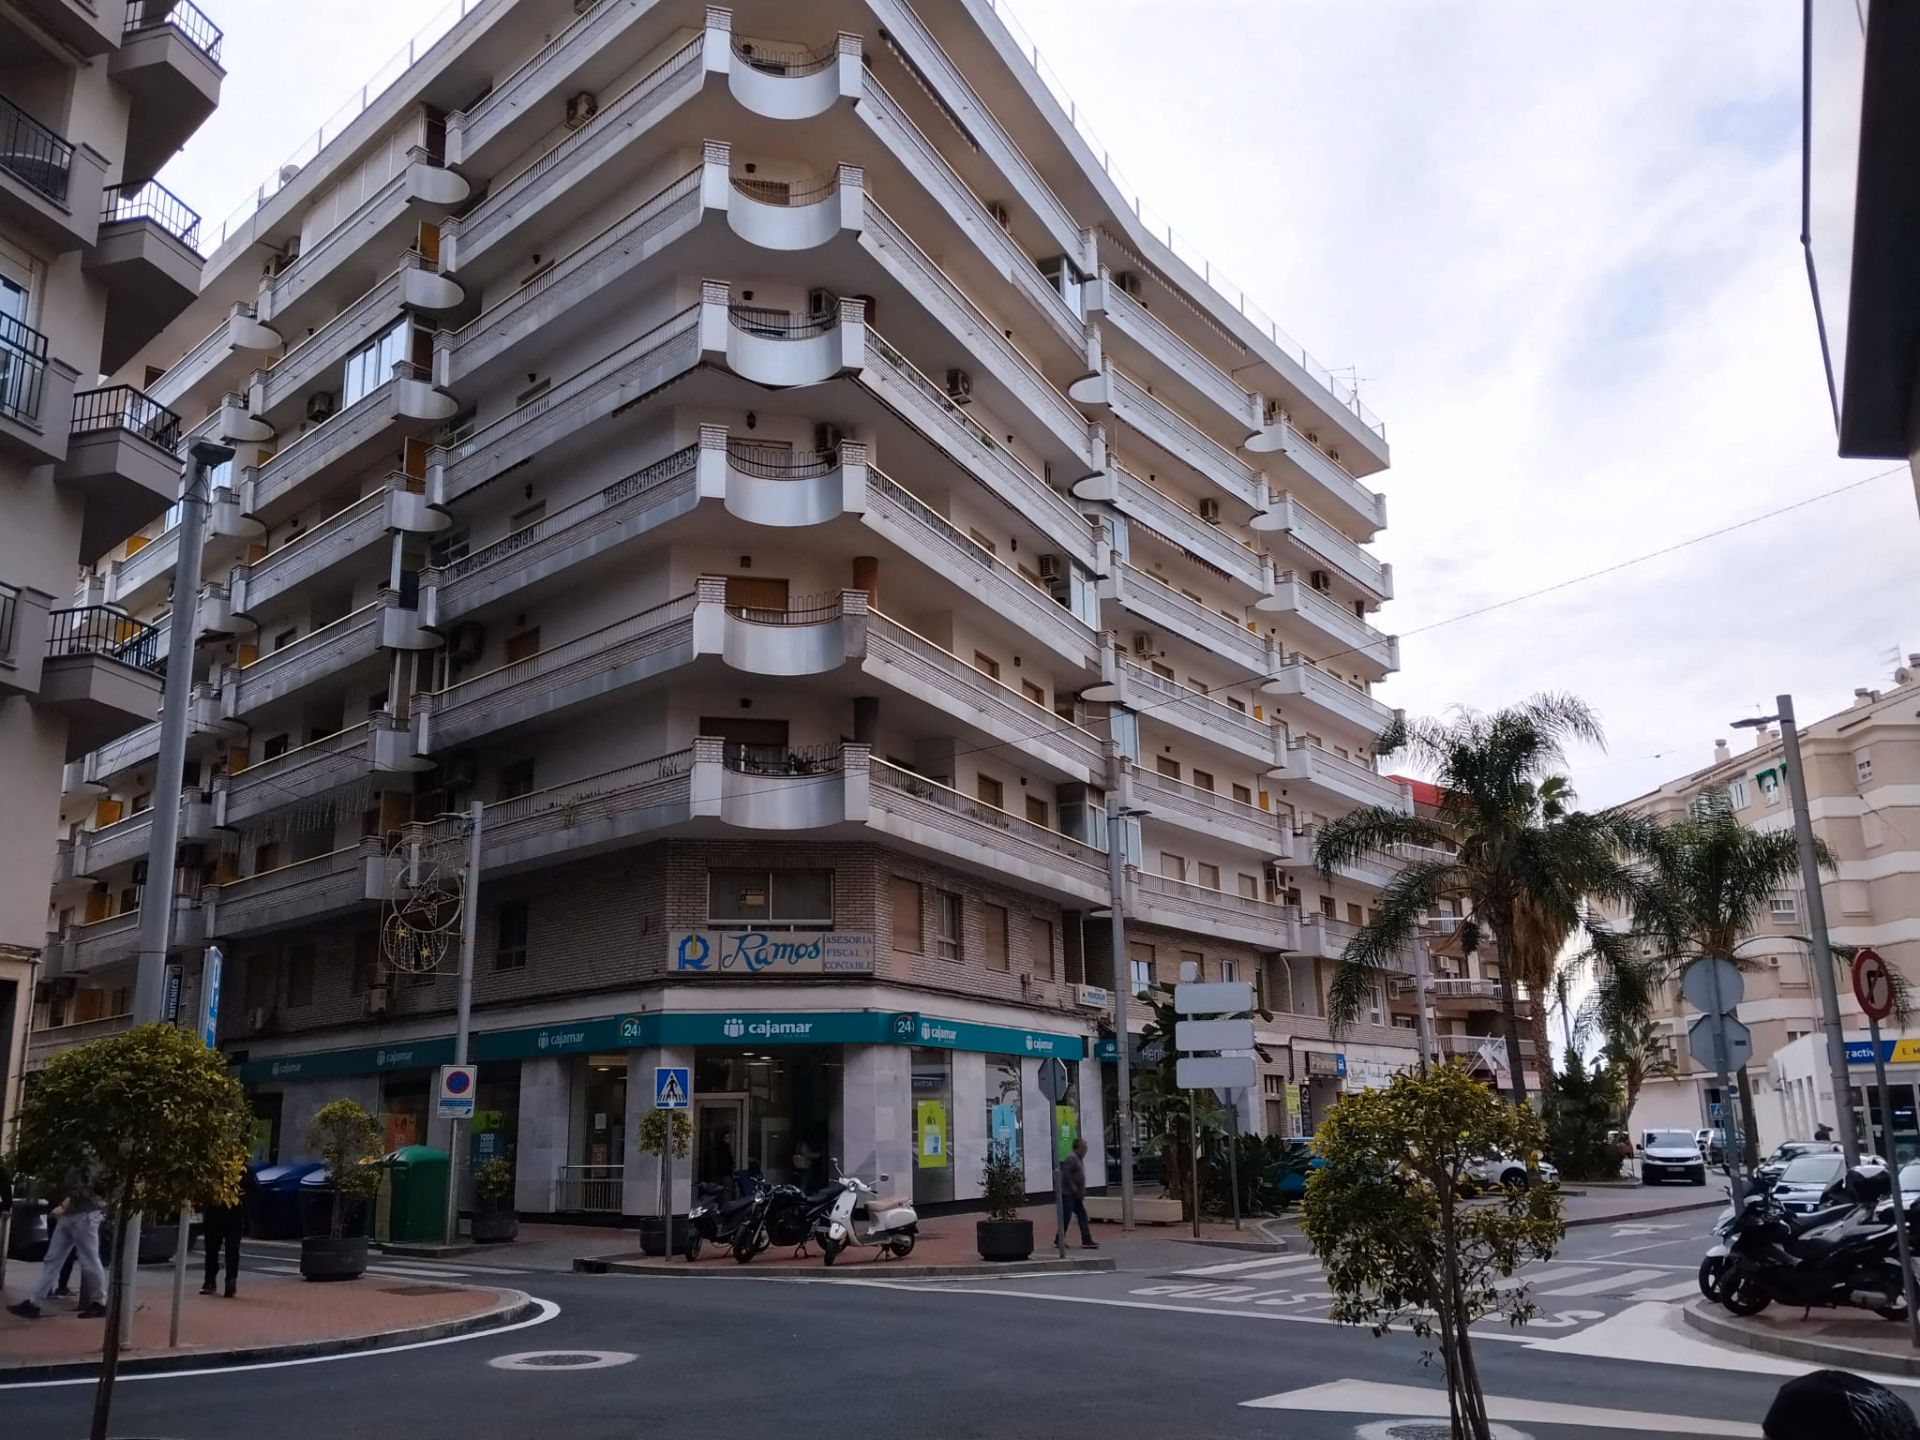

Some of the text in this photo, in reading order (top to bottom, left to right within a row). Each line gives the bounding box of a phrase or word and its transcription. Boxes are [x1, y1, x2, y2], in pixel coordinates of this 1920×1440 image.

[722, 933, 821, 973] Ramos
[826, 949, 859, 957] FISCAL
[824, 961, 873, 970] CONTABLE
[749, 1020, 812, 1038] cajamar
[931, 1025, 957, 1041] cajamar
[551, 1031, 585, 1048] cajamar
[1033, 1037, 1054, 1052] cajamar
[386, 1050, 413, 1066] cajamar
[1851, 1047, 1876, 1058] activ
